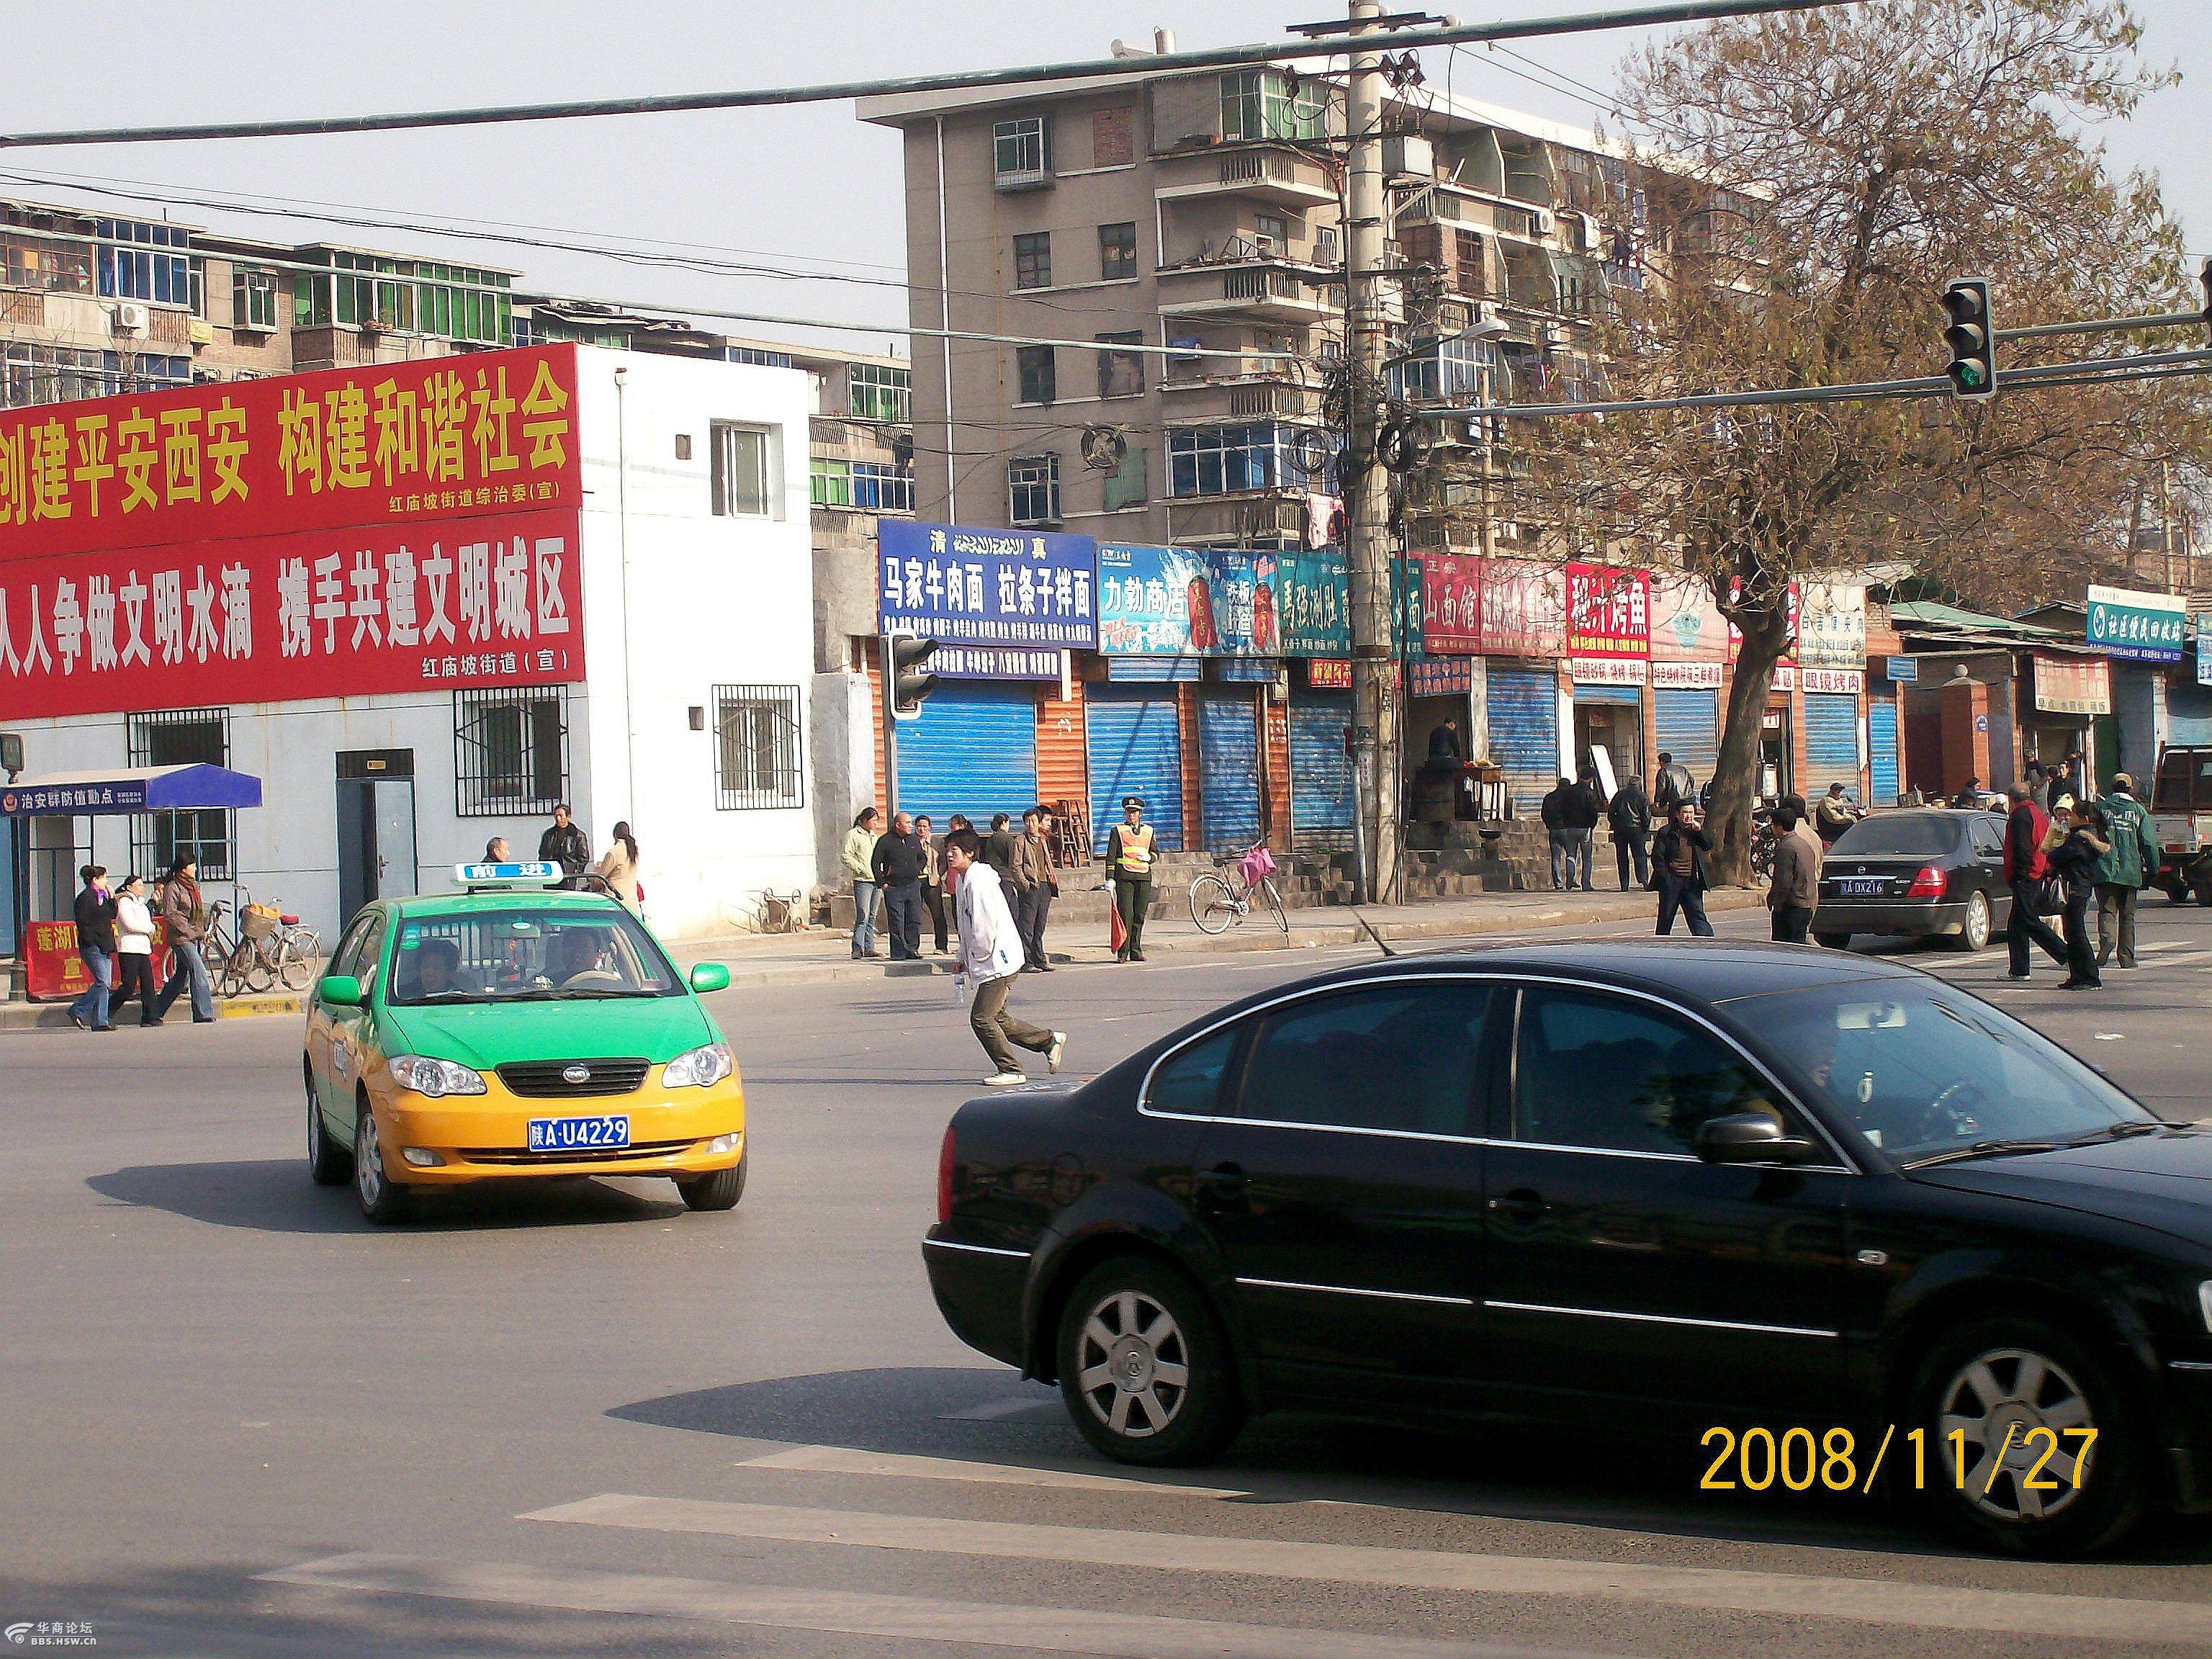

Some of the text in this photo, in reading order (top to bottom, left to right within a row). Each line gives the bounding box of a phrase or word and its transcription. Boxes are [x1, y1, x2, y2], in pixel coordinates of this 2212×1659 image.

[0, 359, 569, 526] 创建平安西安 构建和谐社会
[389, 481, 559, 513] 红庙坡街道综治委（宣）
[930, 529, 946, 553] 清
[1031, 536, 1047, 559] 真
[1426, 560, 1457, 575] 正宗
[884, 556, 1090, 618] 马家牛肉面 拉条子拌面
[0, 535, 570, 678] 人人争做文明水滴 携手共建文明城区
[1806, 672, 1859, 691] 眼镜烤肉
[469, 863, 547, 878] 前进
[531, 1120, 627, 1146] 陕A·U4229
